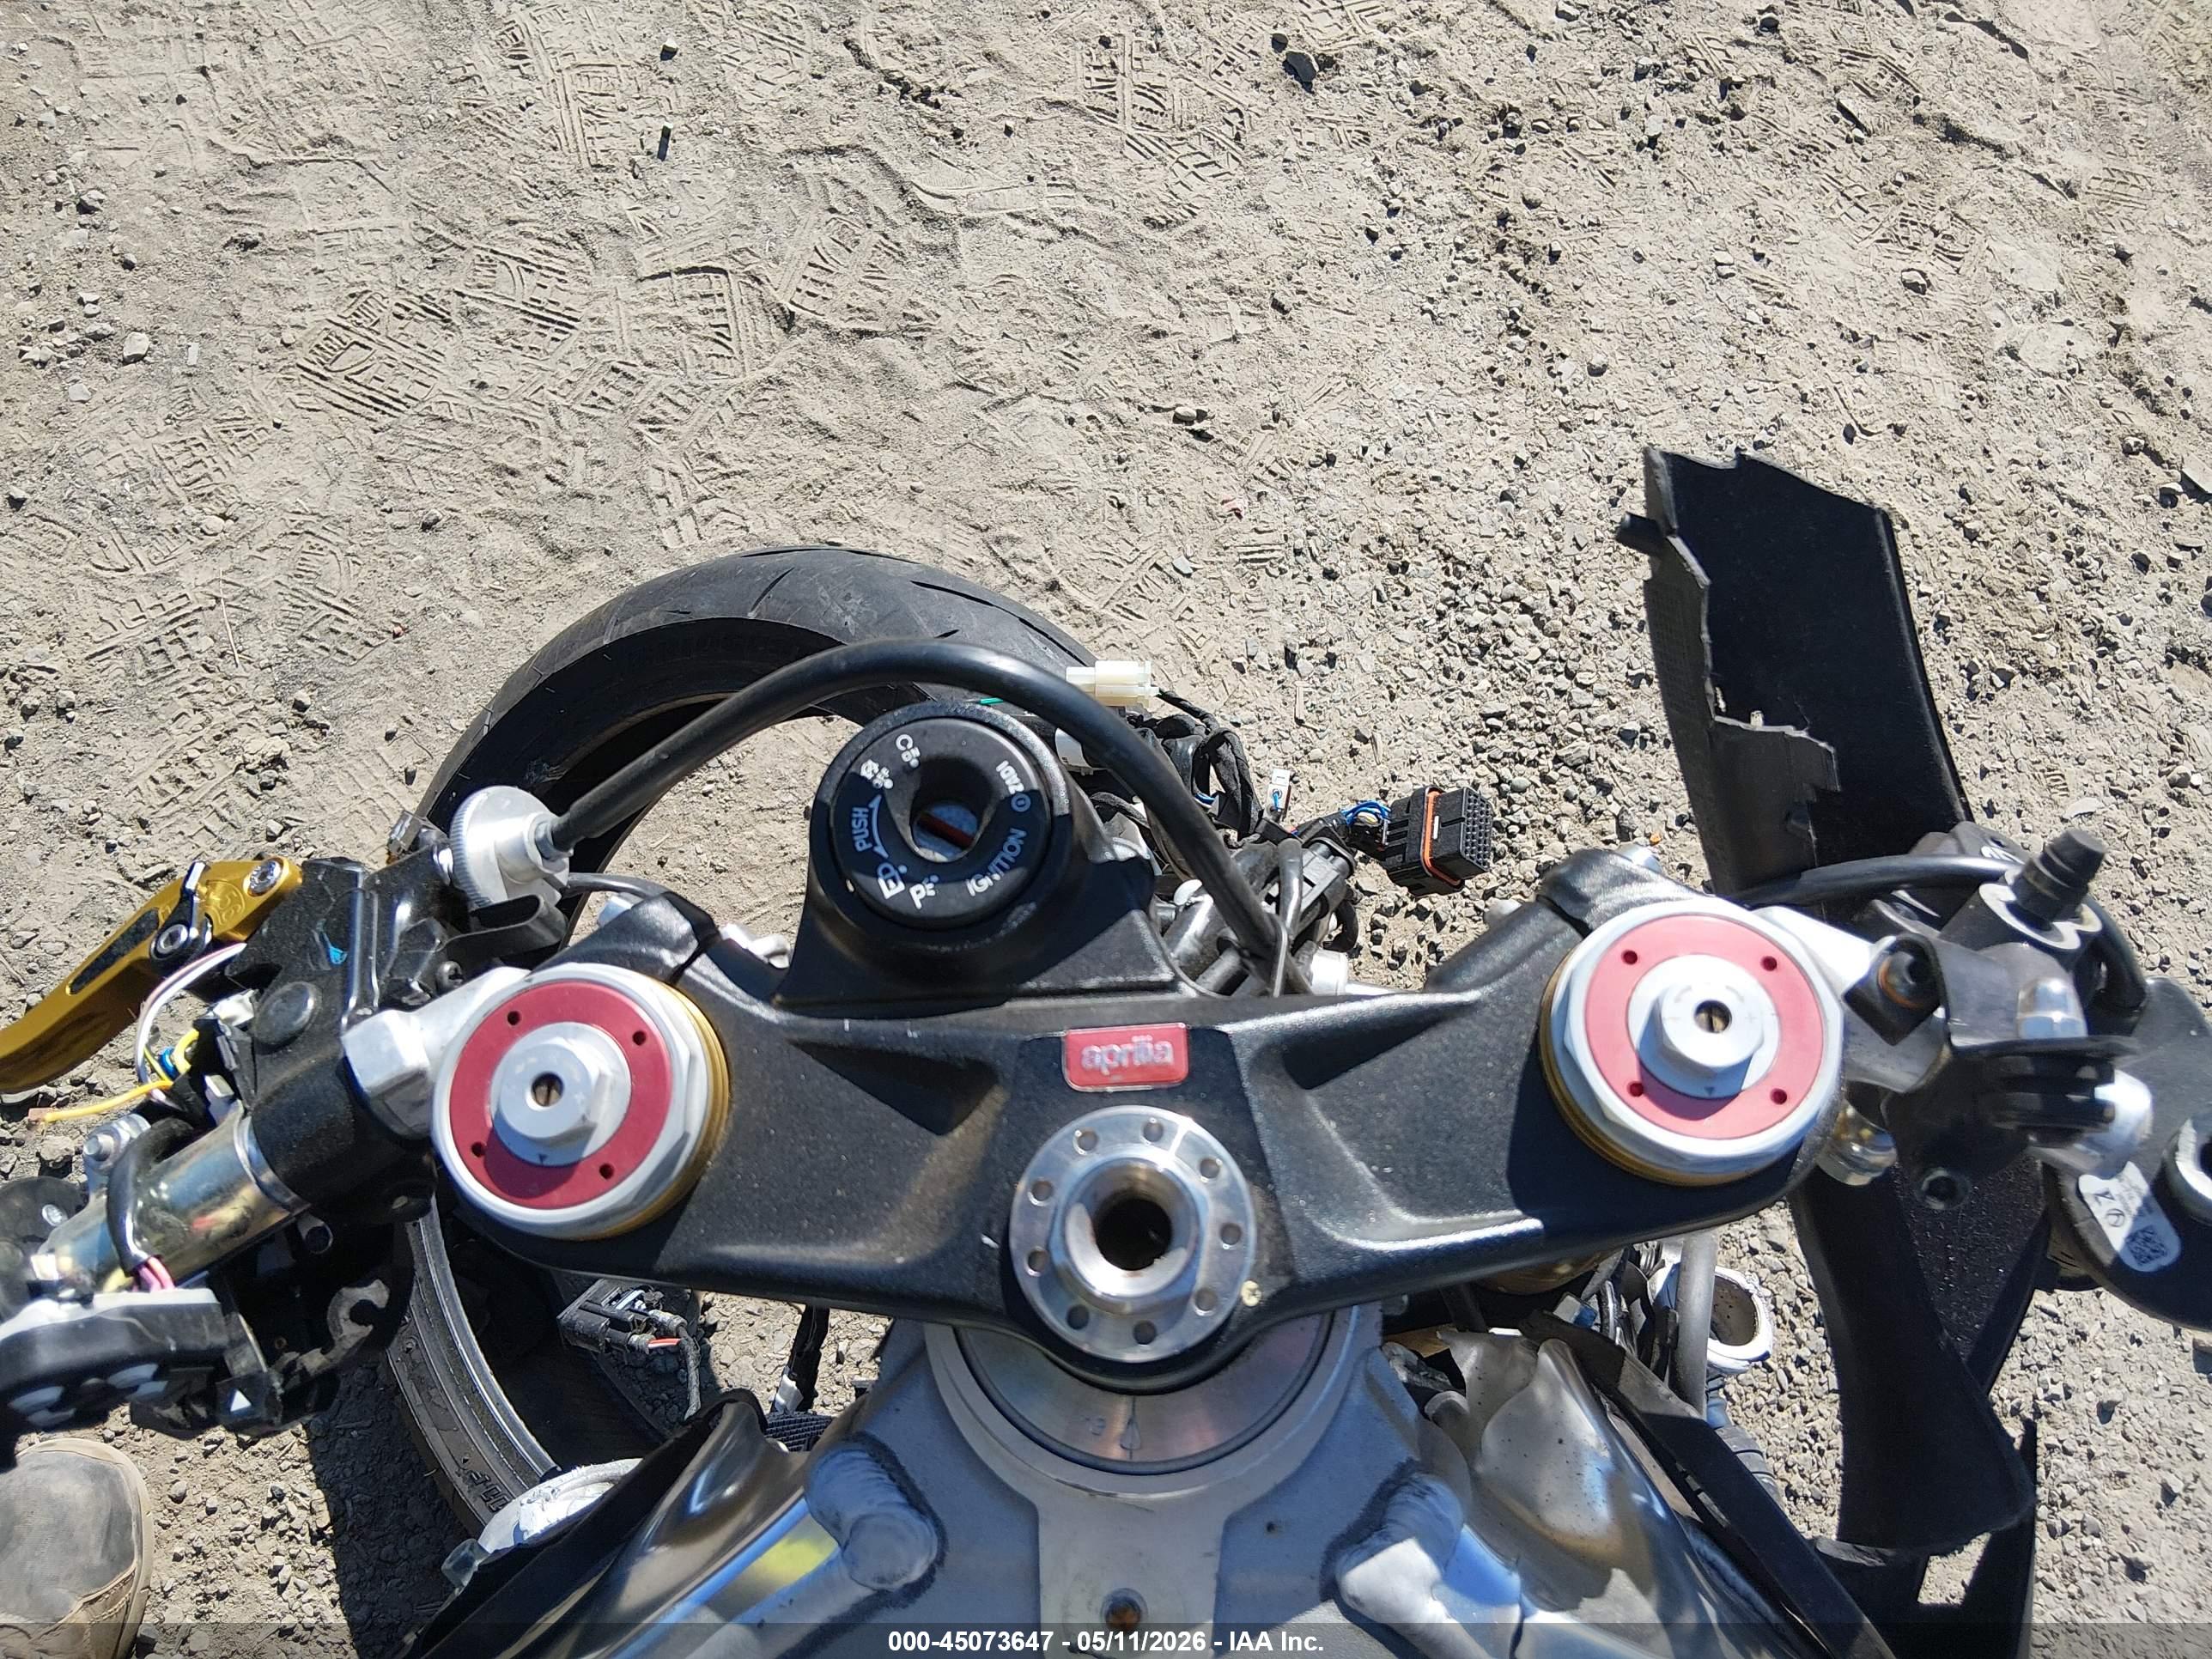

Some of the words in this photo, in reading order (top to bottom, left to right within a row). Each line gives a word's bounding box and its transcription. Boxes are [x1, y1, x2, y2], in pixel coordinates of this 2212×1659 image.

[851, 806, 872, 852] PUSH
[965, 827, 1028, 896] IGNITION
[1081, 1034, 1175, 1076] aprilia
